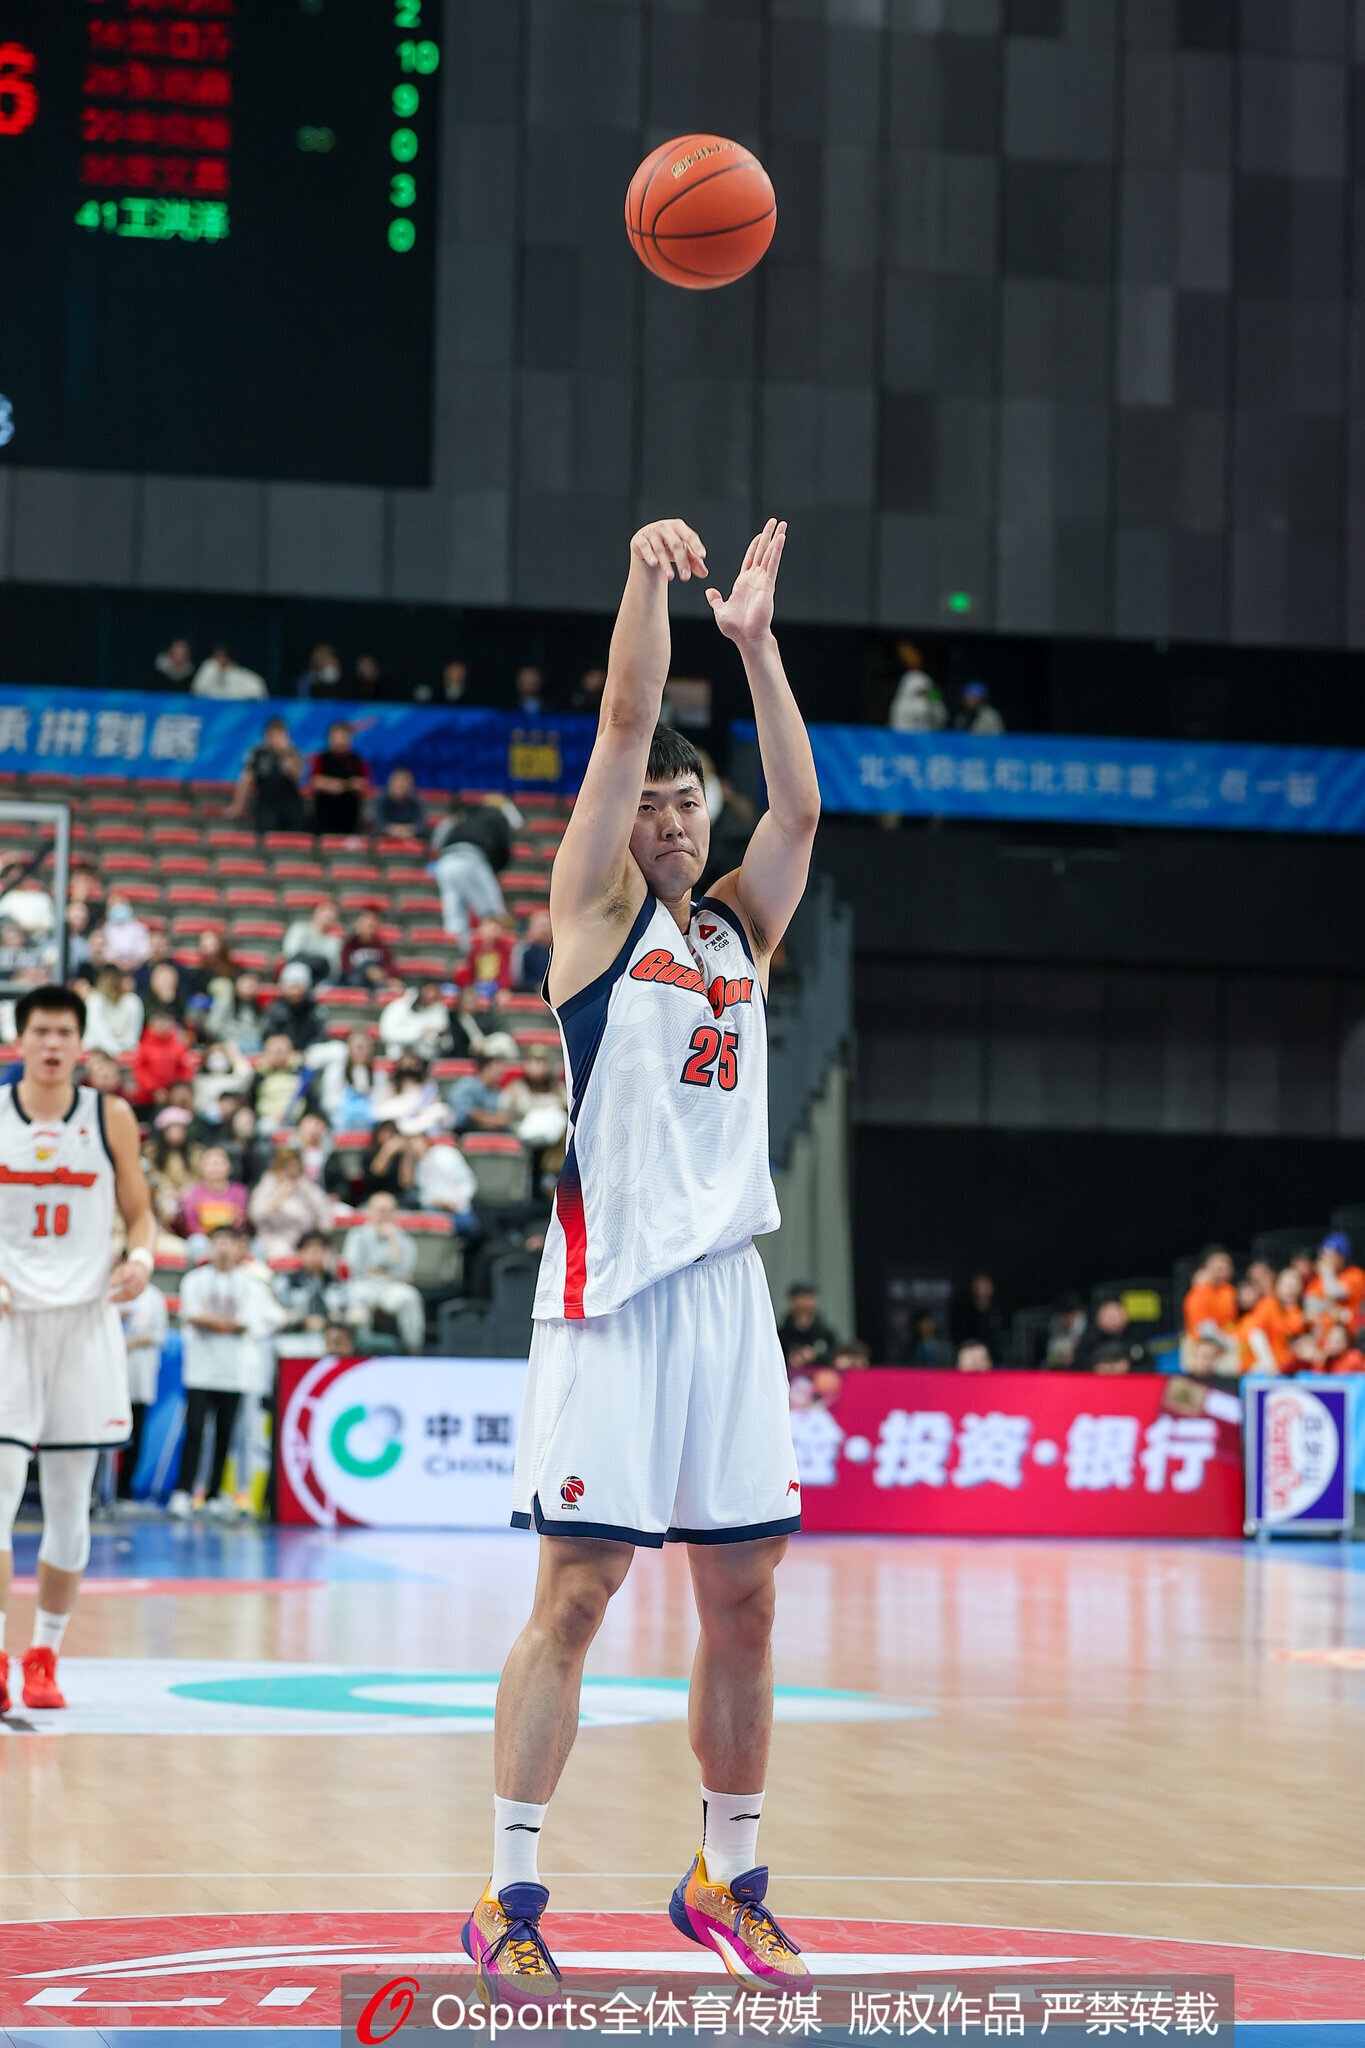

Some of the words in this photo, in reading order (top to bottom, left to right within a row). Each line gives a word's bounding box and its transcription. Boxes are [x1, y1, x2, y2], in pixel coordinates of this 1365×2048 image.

[395, 40, 440, 75] 10
[390, 127, 419, 163] 0
[387, 217, 416, 253] 0
[713, 939, 730, 952] CGB
[680, 1025, 739, 1091] 25
[33, 1204, 69, 1237] 10
[424, 1411, 511, 1446] 中国
[423, 1455, 515, 1477] CHIN
